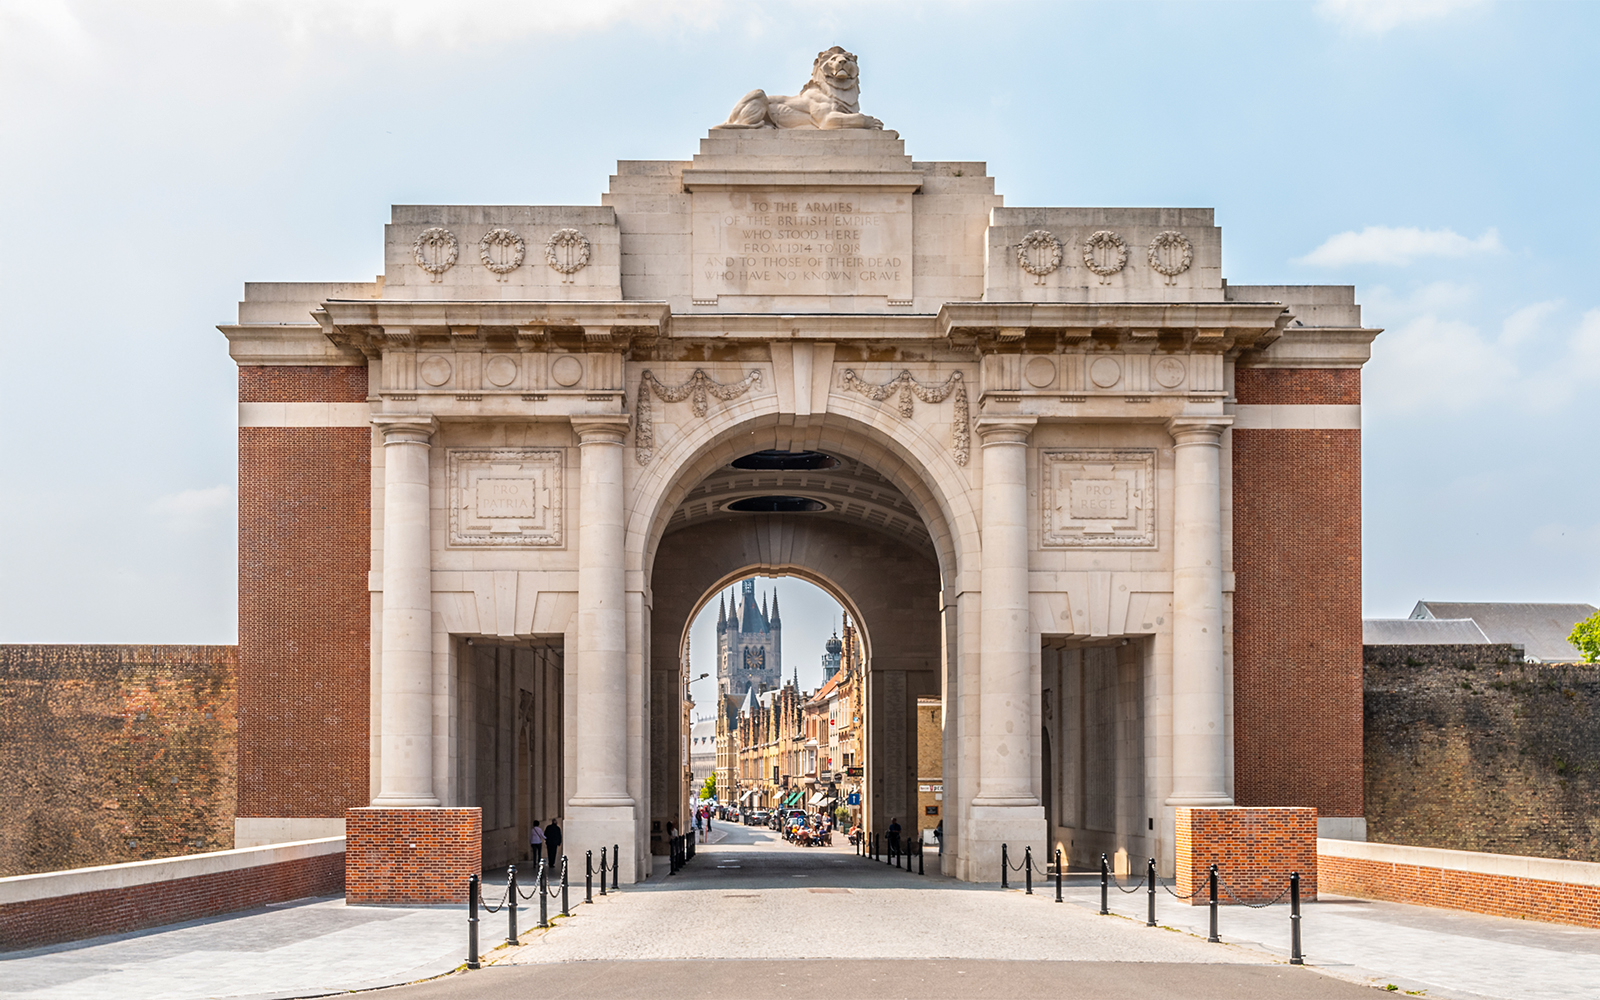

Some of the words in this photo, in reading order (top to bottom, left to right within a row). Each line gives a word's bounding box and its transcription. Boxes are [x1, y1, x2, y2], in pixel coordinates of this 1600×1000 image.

[752, 202, 769, 212] TO
[774, 202, 797, 212] THE
[805, 202, 852, 212] ARMIES
[724, 216, 740, 226] OF
[747, 216, 770, 226] THE
[778, 216, 827, 226] BRITISH
[835, 216, 879, 226] EMPIRE
[743, 230, 771, 240] WHO
[778, 230, 818, 240] STOOD
[825, 230, 859, 240] HERE
[745, 243, 782, 253] FROM
[787, 243, 812, 253] 1914
[818, 243, 834, 253] TO
[838, 243, 860, 253] 1918
[705, 257, 734, 267] AND
[742, 257, 756, 267] TO
[761, 257, 801, 267] THOSE
[808, 257, 823, 267] OF
[828, 257, 864, 267] THEIR
[869, 257, 901, 267] DEAD
[705, 271, 734, 281] WHO
[740, 271, 770, 281] HAVE
[778, 271, 796, 281] NO
[804, 271, 851, 281] KNOWN
[860, 271, 900, 281] GRAVE
[493, 485, 518, 494] PRO
[1086, 486, 1112, 495] PRO
[483, 499, 528, 508] PATRIA
[1081, 499, 1116, 509] REGE
